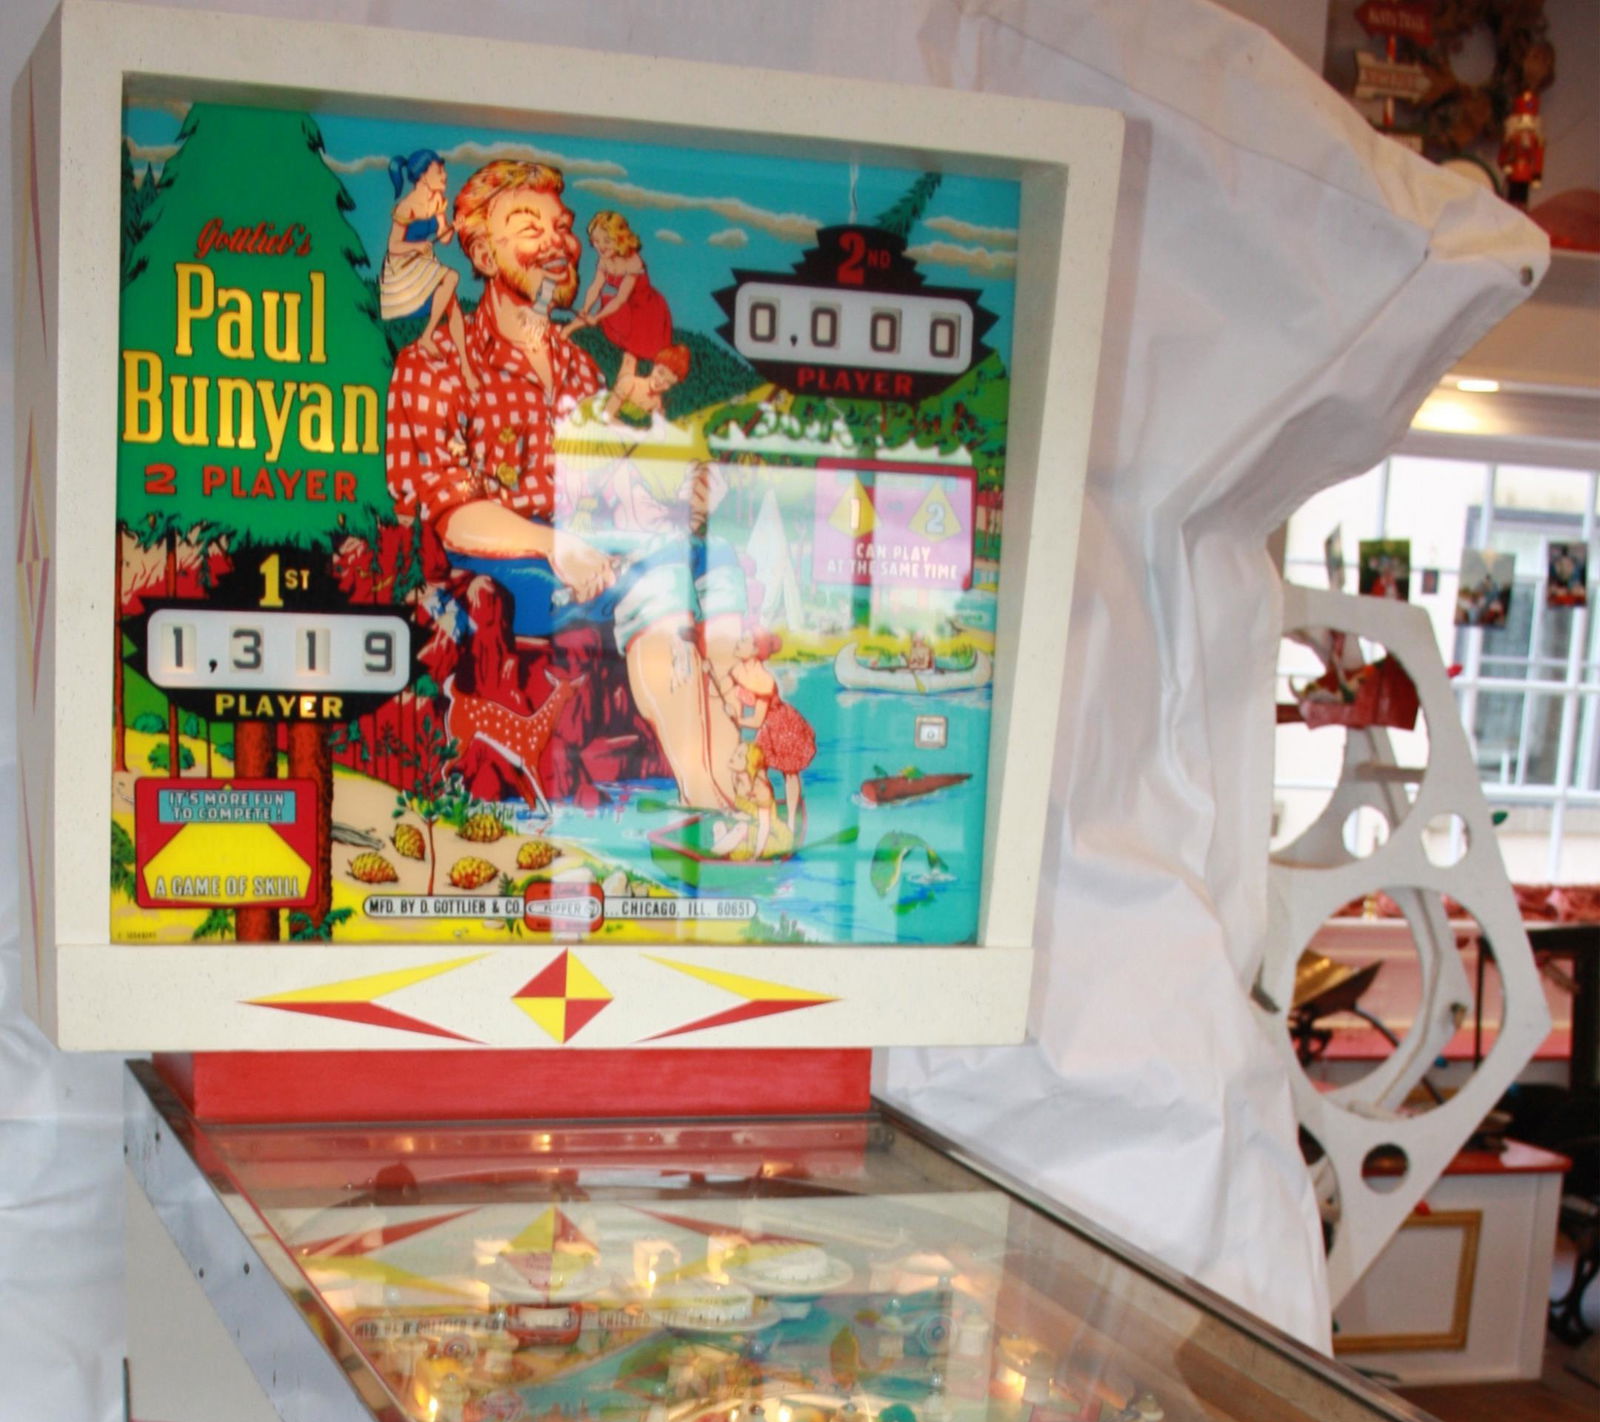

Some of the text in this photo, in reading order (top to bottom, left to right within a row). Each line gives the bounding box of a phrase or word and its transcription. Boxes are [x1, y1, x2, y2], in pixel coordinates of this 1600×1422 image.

[194, 217, 312, 259] Gottlieb's
[836, 230, 892, 285] 2ND
[174, 262, 327, 364] Paul
[796, 367, 914, 396] PLAYER
[122, 350, 381, 462] Bunyan
[144, 464, 358, 502] 2 PLAYER
[850, 498, 861, 531] 1
[925, 502, 945, 534] 2
[856, 543, 931, 561] CAN PLAY
[259, 553, 311, 608] 1ST
[827, 559, 958, 580] AT THE SAME TIME
[215, 694, 344, 719] PLAYER
[168, 792, 285, 806] IT'S MORE FUN
[173, 807, 193, 819] TO
[155, 876, 299, 897] A GAME OF SKILL
[369, 899, 396, 914] MFD.
[400, 899, 415, 914] BY
[420, 899, 430, 914] D.
[433, 899, 486, 914] GOTTLIEB
[492, 899, 500, 914] &
